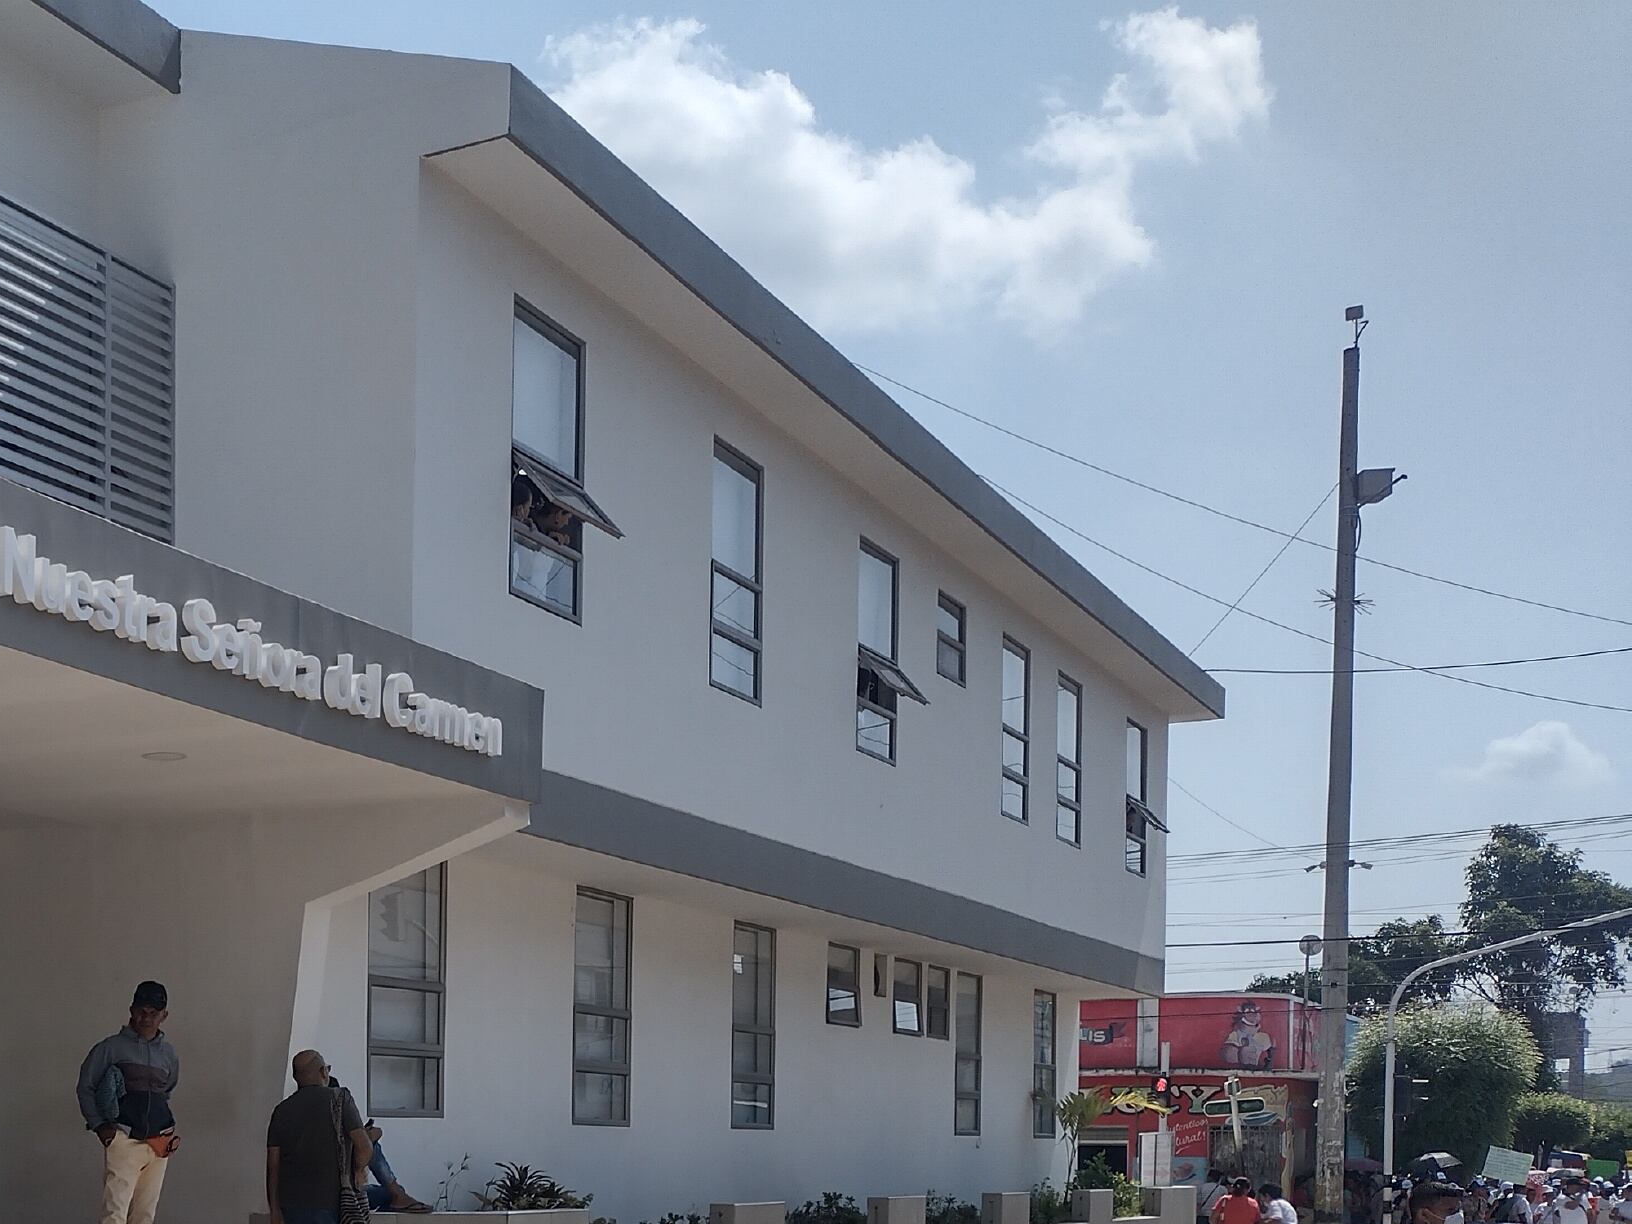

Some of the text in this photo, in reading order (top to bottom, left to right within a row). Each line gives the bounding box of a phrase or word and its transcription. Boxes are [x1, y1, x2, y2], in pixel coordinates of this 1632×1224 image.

[181, 597, 322, 701] Señora
[323, 653, 382, 719] del
[383, 671, 504, 757] Carmen
